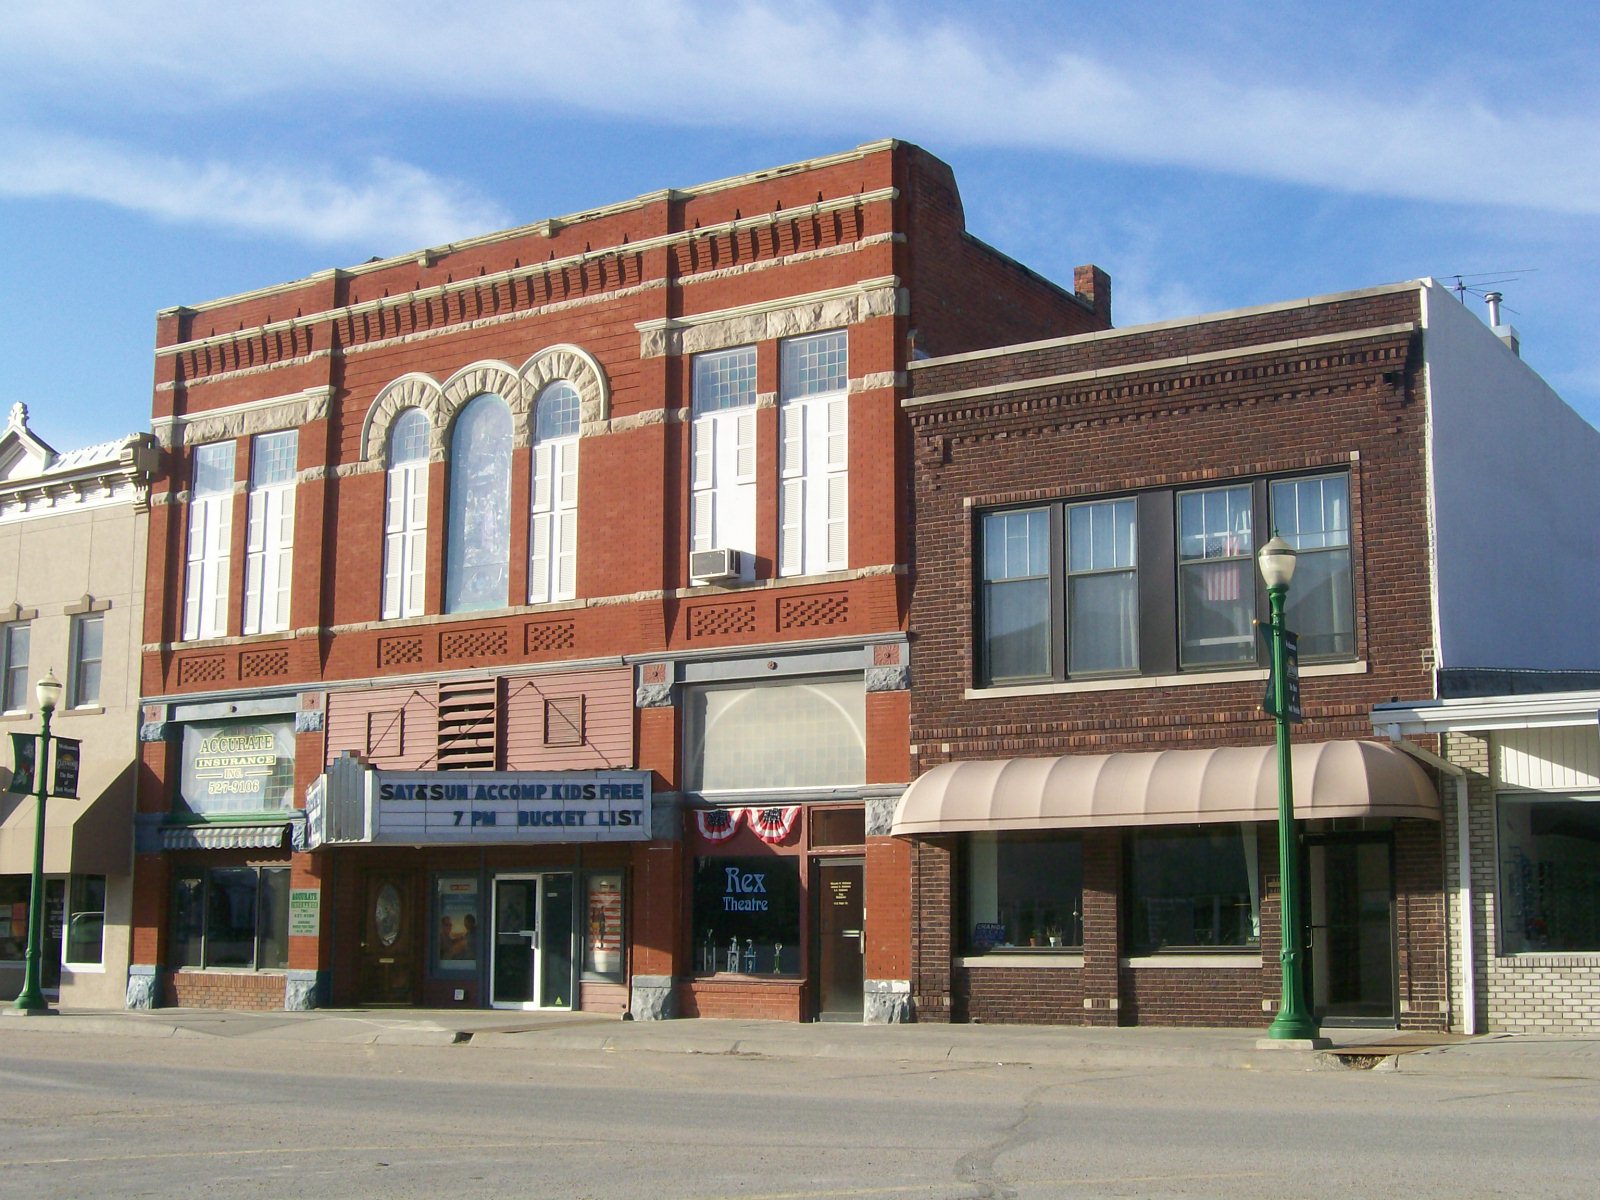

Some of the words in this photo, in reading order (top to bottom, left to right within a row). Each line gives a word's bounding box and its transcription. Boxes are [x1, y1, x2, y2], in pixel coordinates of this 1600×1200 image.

[200, 734, 273, 753] ACCURATE
[199, 756, 274, 767] INSURANCE
[224, 768, 243, 779] INC.
[208, 780, 260, 795] 527-9106
[475, 784, 547, 800] ACCOMP
[551, 784, 596, 800] KIDS
[600, 784, 644, 800] FREE
[453, 810, 464, 826] 7
[471, 810, 496, 827] PM
[517, 810, 587, 826] BUCKET
[598, 809, 641, 826] LIST
[725, 867, 766, 893] Rex
[722, 896, 768, 911] Theatre
